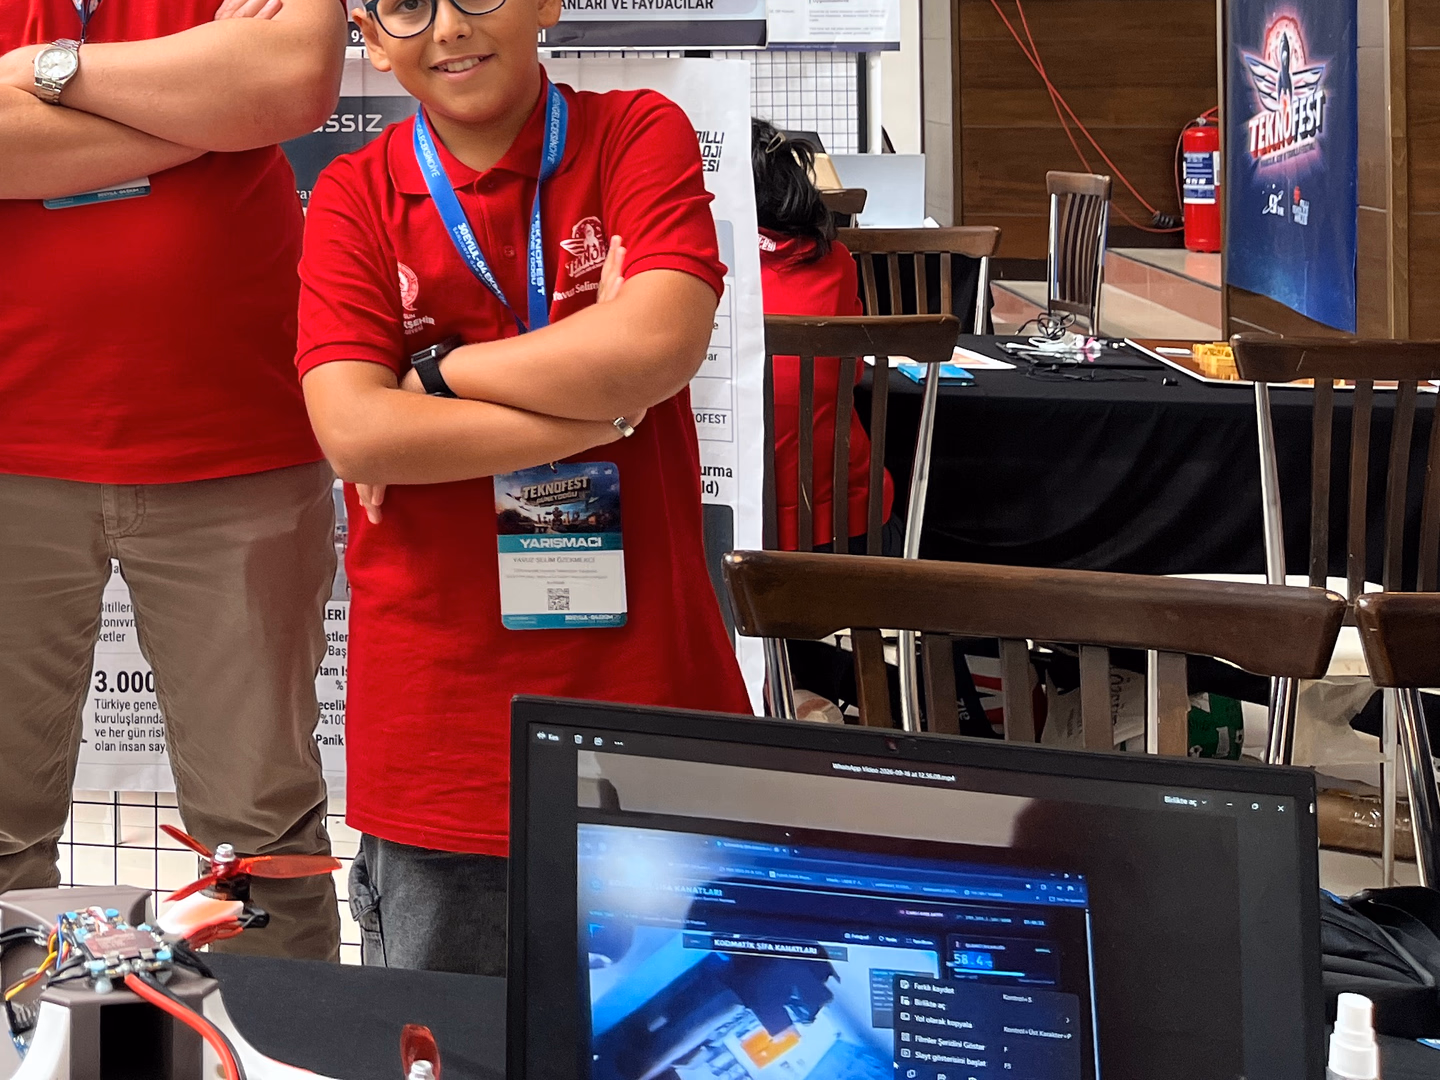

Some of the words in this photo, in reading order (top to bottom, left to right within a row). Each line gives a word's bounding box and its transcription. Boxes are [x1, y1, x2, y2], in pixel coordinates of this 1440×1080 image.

[1249, 90, 1327, 159] TEKNOFEST
[522, 476, 591, 500] TEKNOFEST
[520, 536, 602, 550] YARIŞMACI
[94, 698, 130, 710] Türkiye
[94, 729, 106, 738] ve
[109, 727, 125, 737] her
[128, 728, 146, 740] gün
[315, 734, 344, 746] Panik
[94, 742, 116, 751] olan
[119, 741, 145, 752] insan
